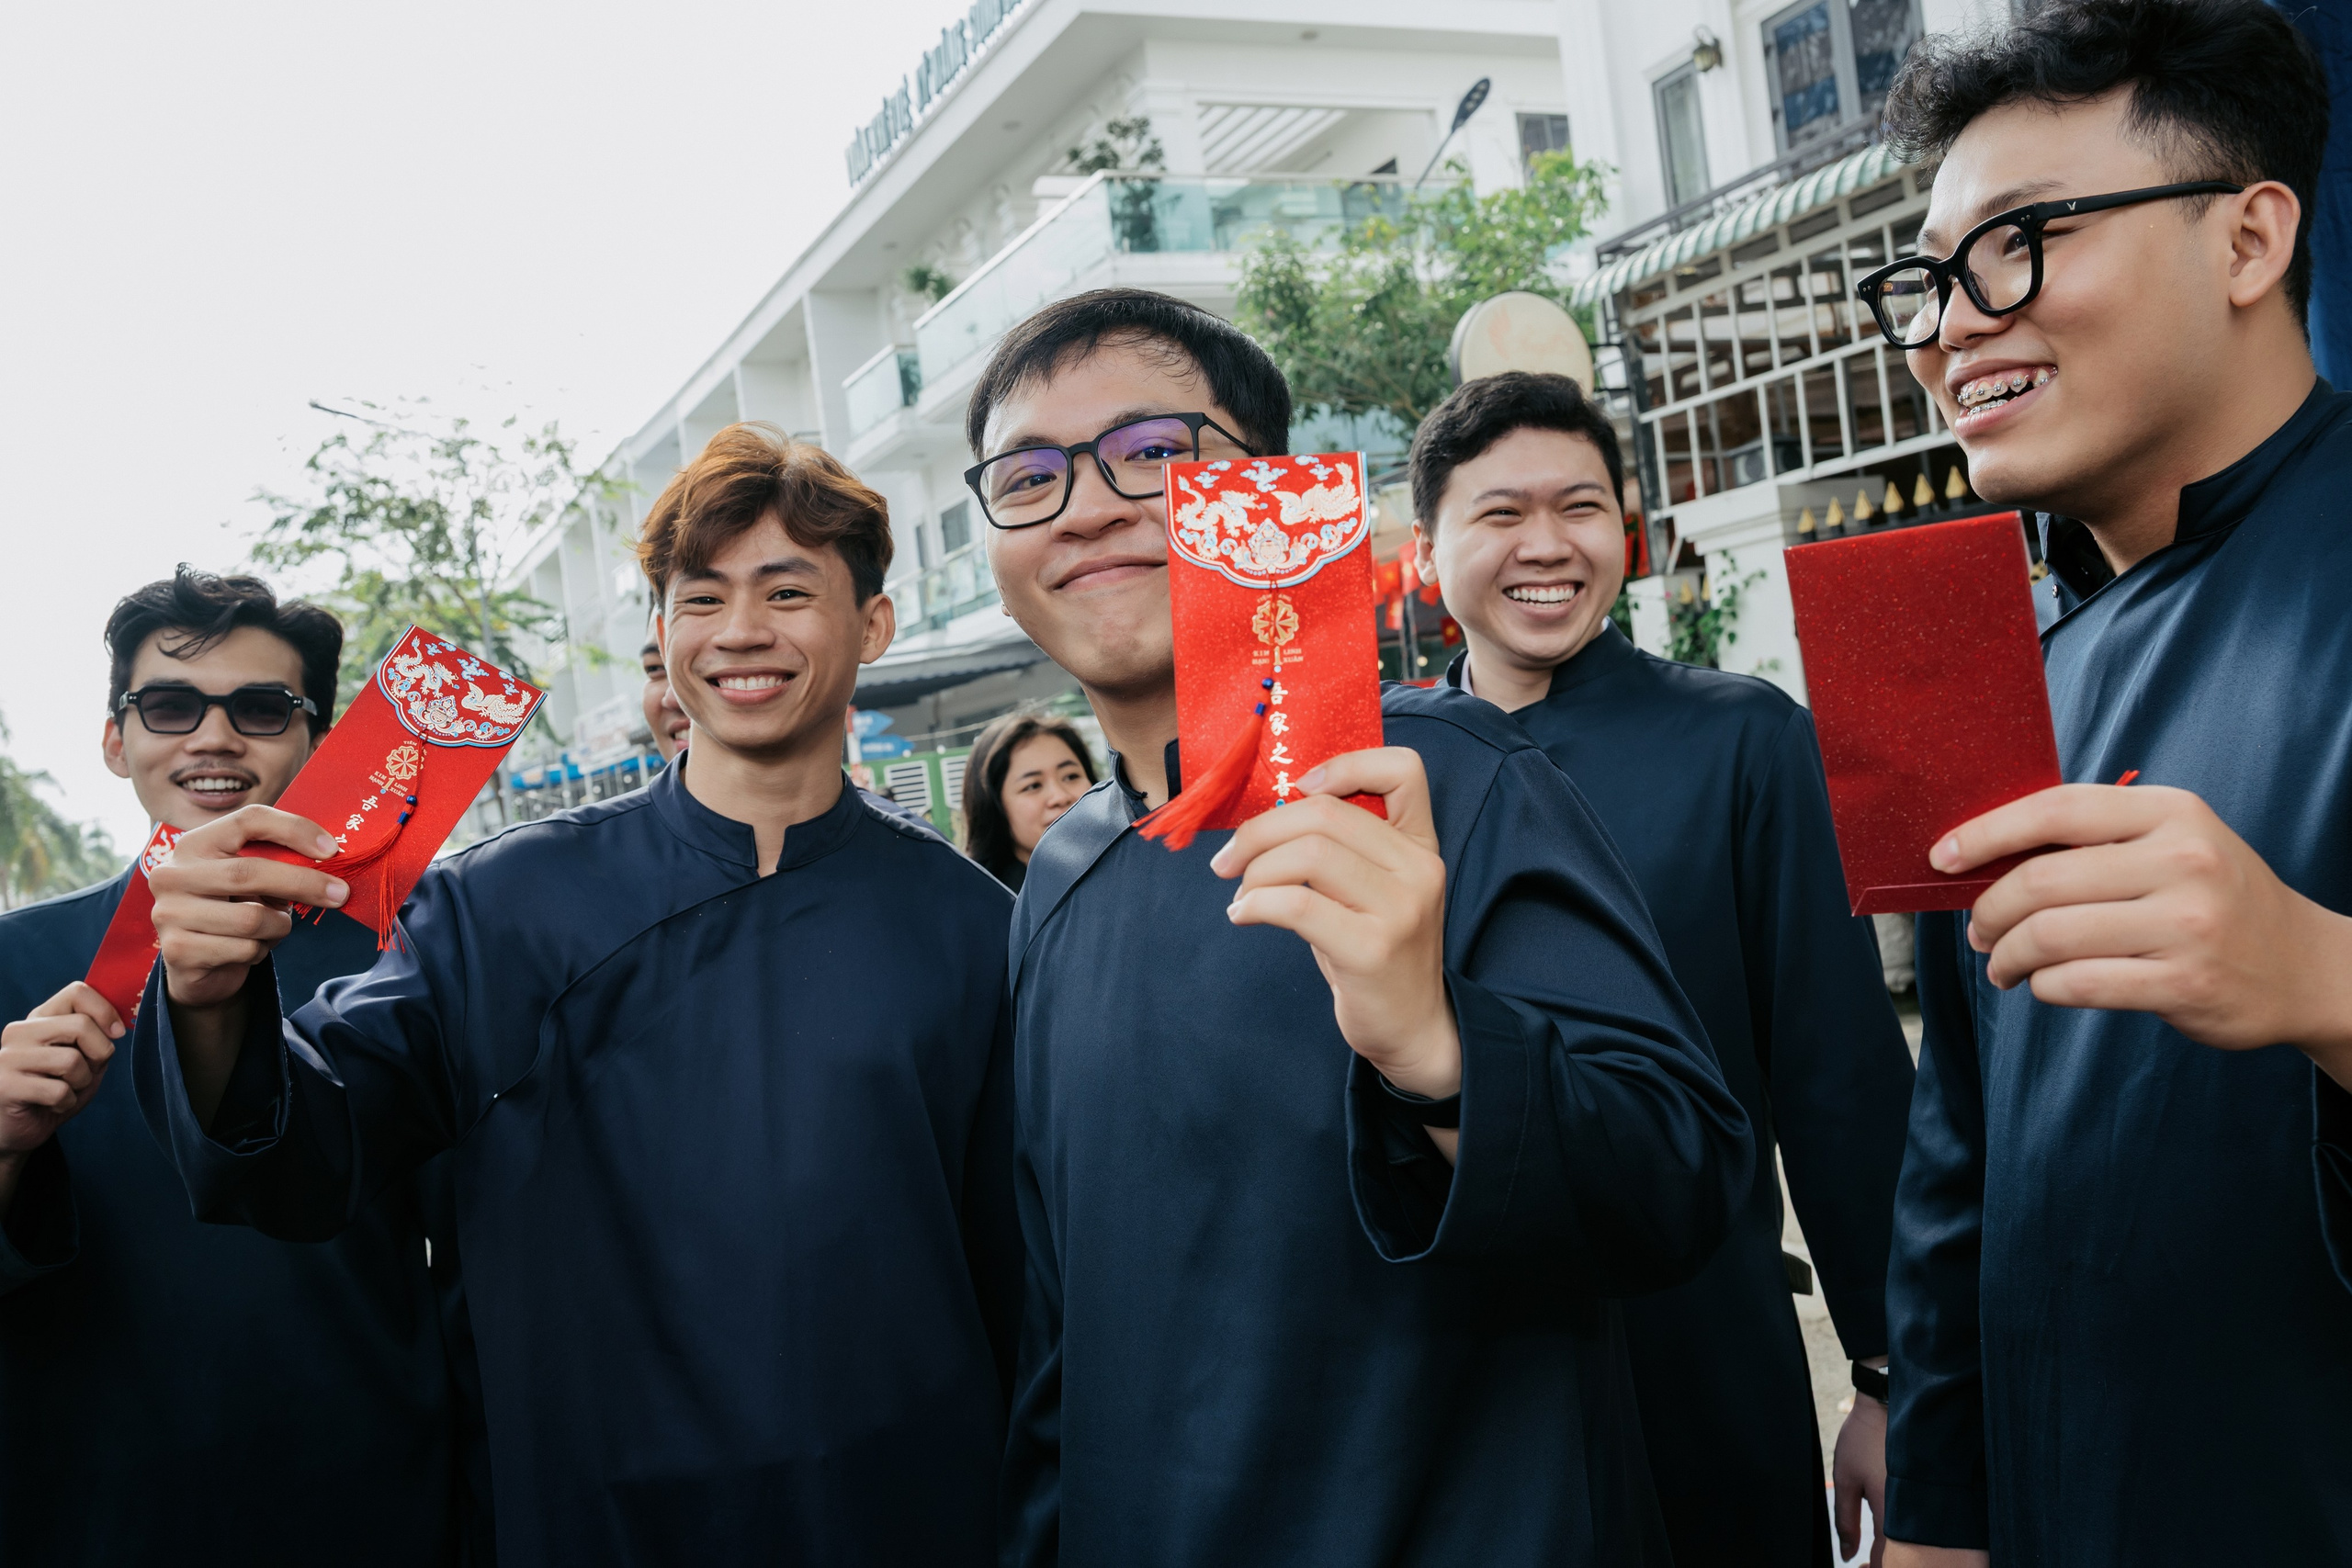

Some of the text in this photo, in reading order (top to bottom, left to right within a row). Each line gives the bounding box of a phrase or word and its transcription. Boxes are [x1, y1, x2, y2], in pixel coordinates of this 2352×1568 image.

[1270, 682, 1295, 796] 吾家之喜
[374, 771, 387, 781] KIM
[394, 783, 408, 792] LINH
